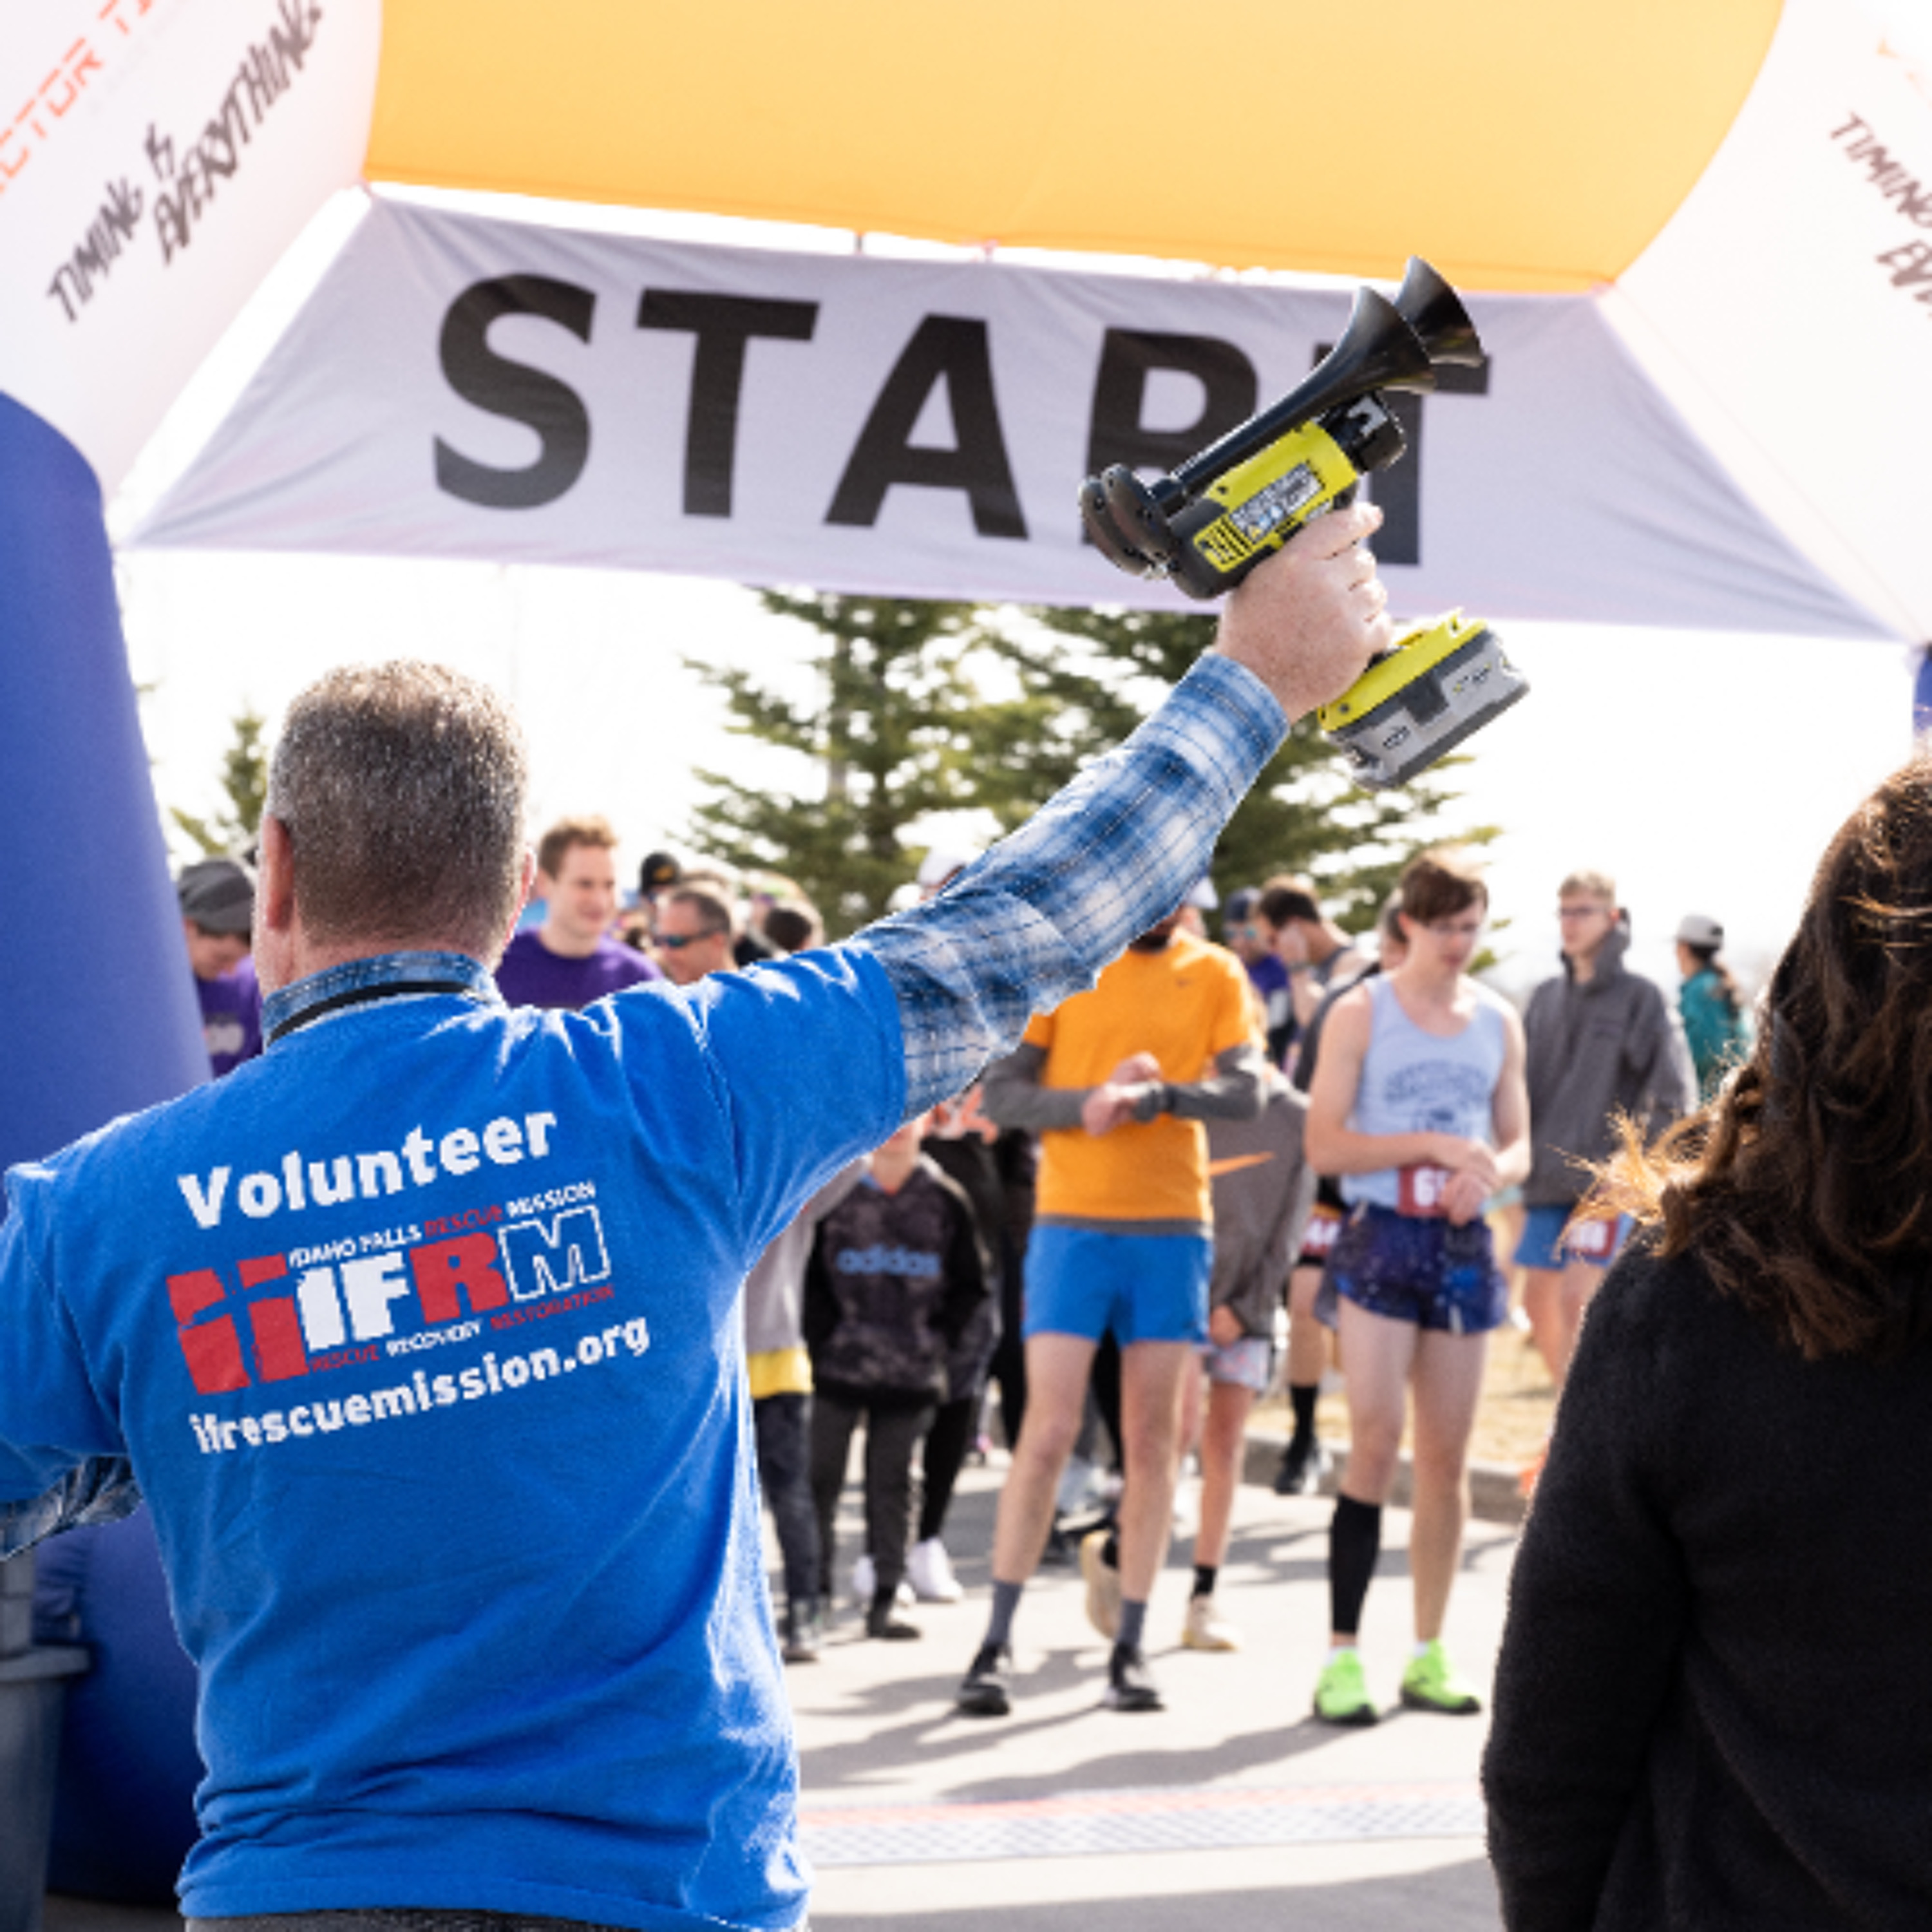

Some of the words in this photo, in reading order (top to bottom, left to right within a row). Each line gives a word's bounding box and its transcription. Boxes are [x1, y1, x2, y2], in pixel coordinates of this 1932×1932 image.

[177, 1112, 557, 1229] Volunteer
[290, 1237, 356, 1267] IDAHO
[360, 1225, 421, 1253] FALLS
[424, 1205, 503, 1237] RESCUE
[506, 1182, 596, 1218] MISSION
[297, 1204, 611, 1353] IFRM
[189, 1316, 650, 1454] ifrescuemission.org
[310, 1345, 379, 1372] RESCUE
[386, 1320, 482, 1357] RECOVERY
